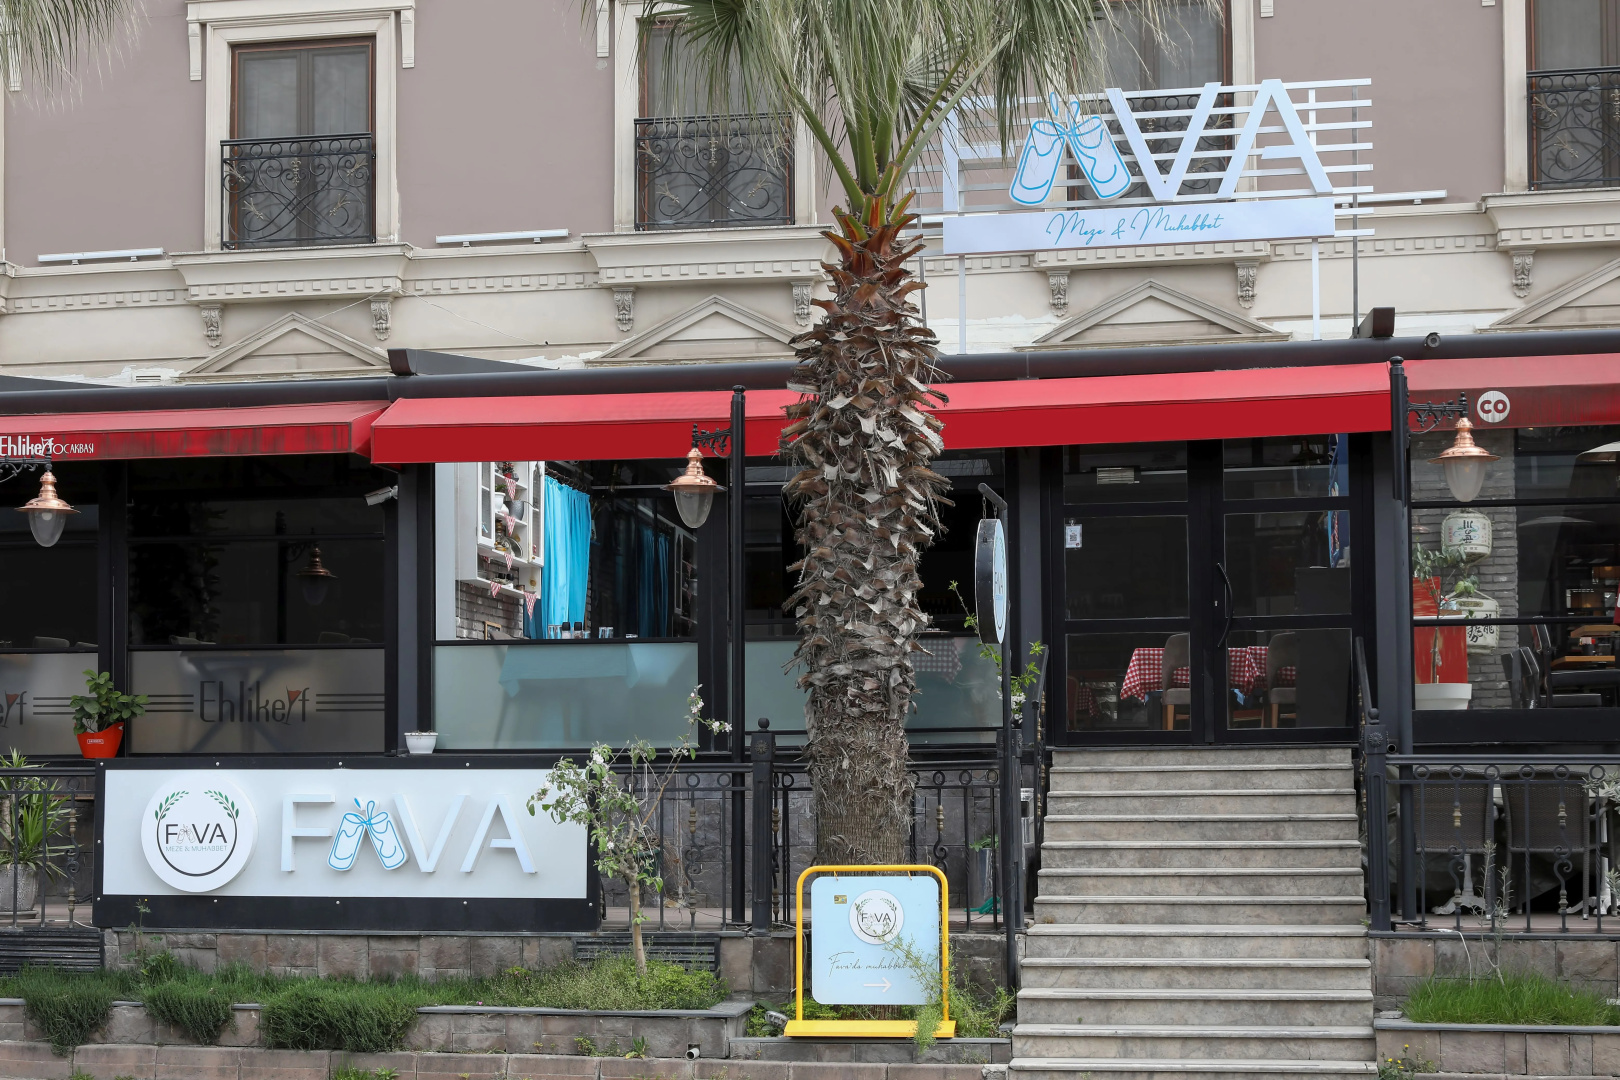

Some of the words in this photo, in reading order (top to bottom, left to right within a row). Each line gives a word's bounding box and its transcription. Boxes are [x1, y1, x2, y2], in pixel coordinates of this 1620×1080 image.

[1046, 211, 1105, 245] Meze
[1111, 218, 1126, 239] &
[1131, 207, 1224, 240] Muhabbet
[1480, 399, 1507, 414] CO
